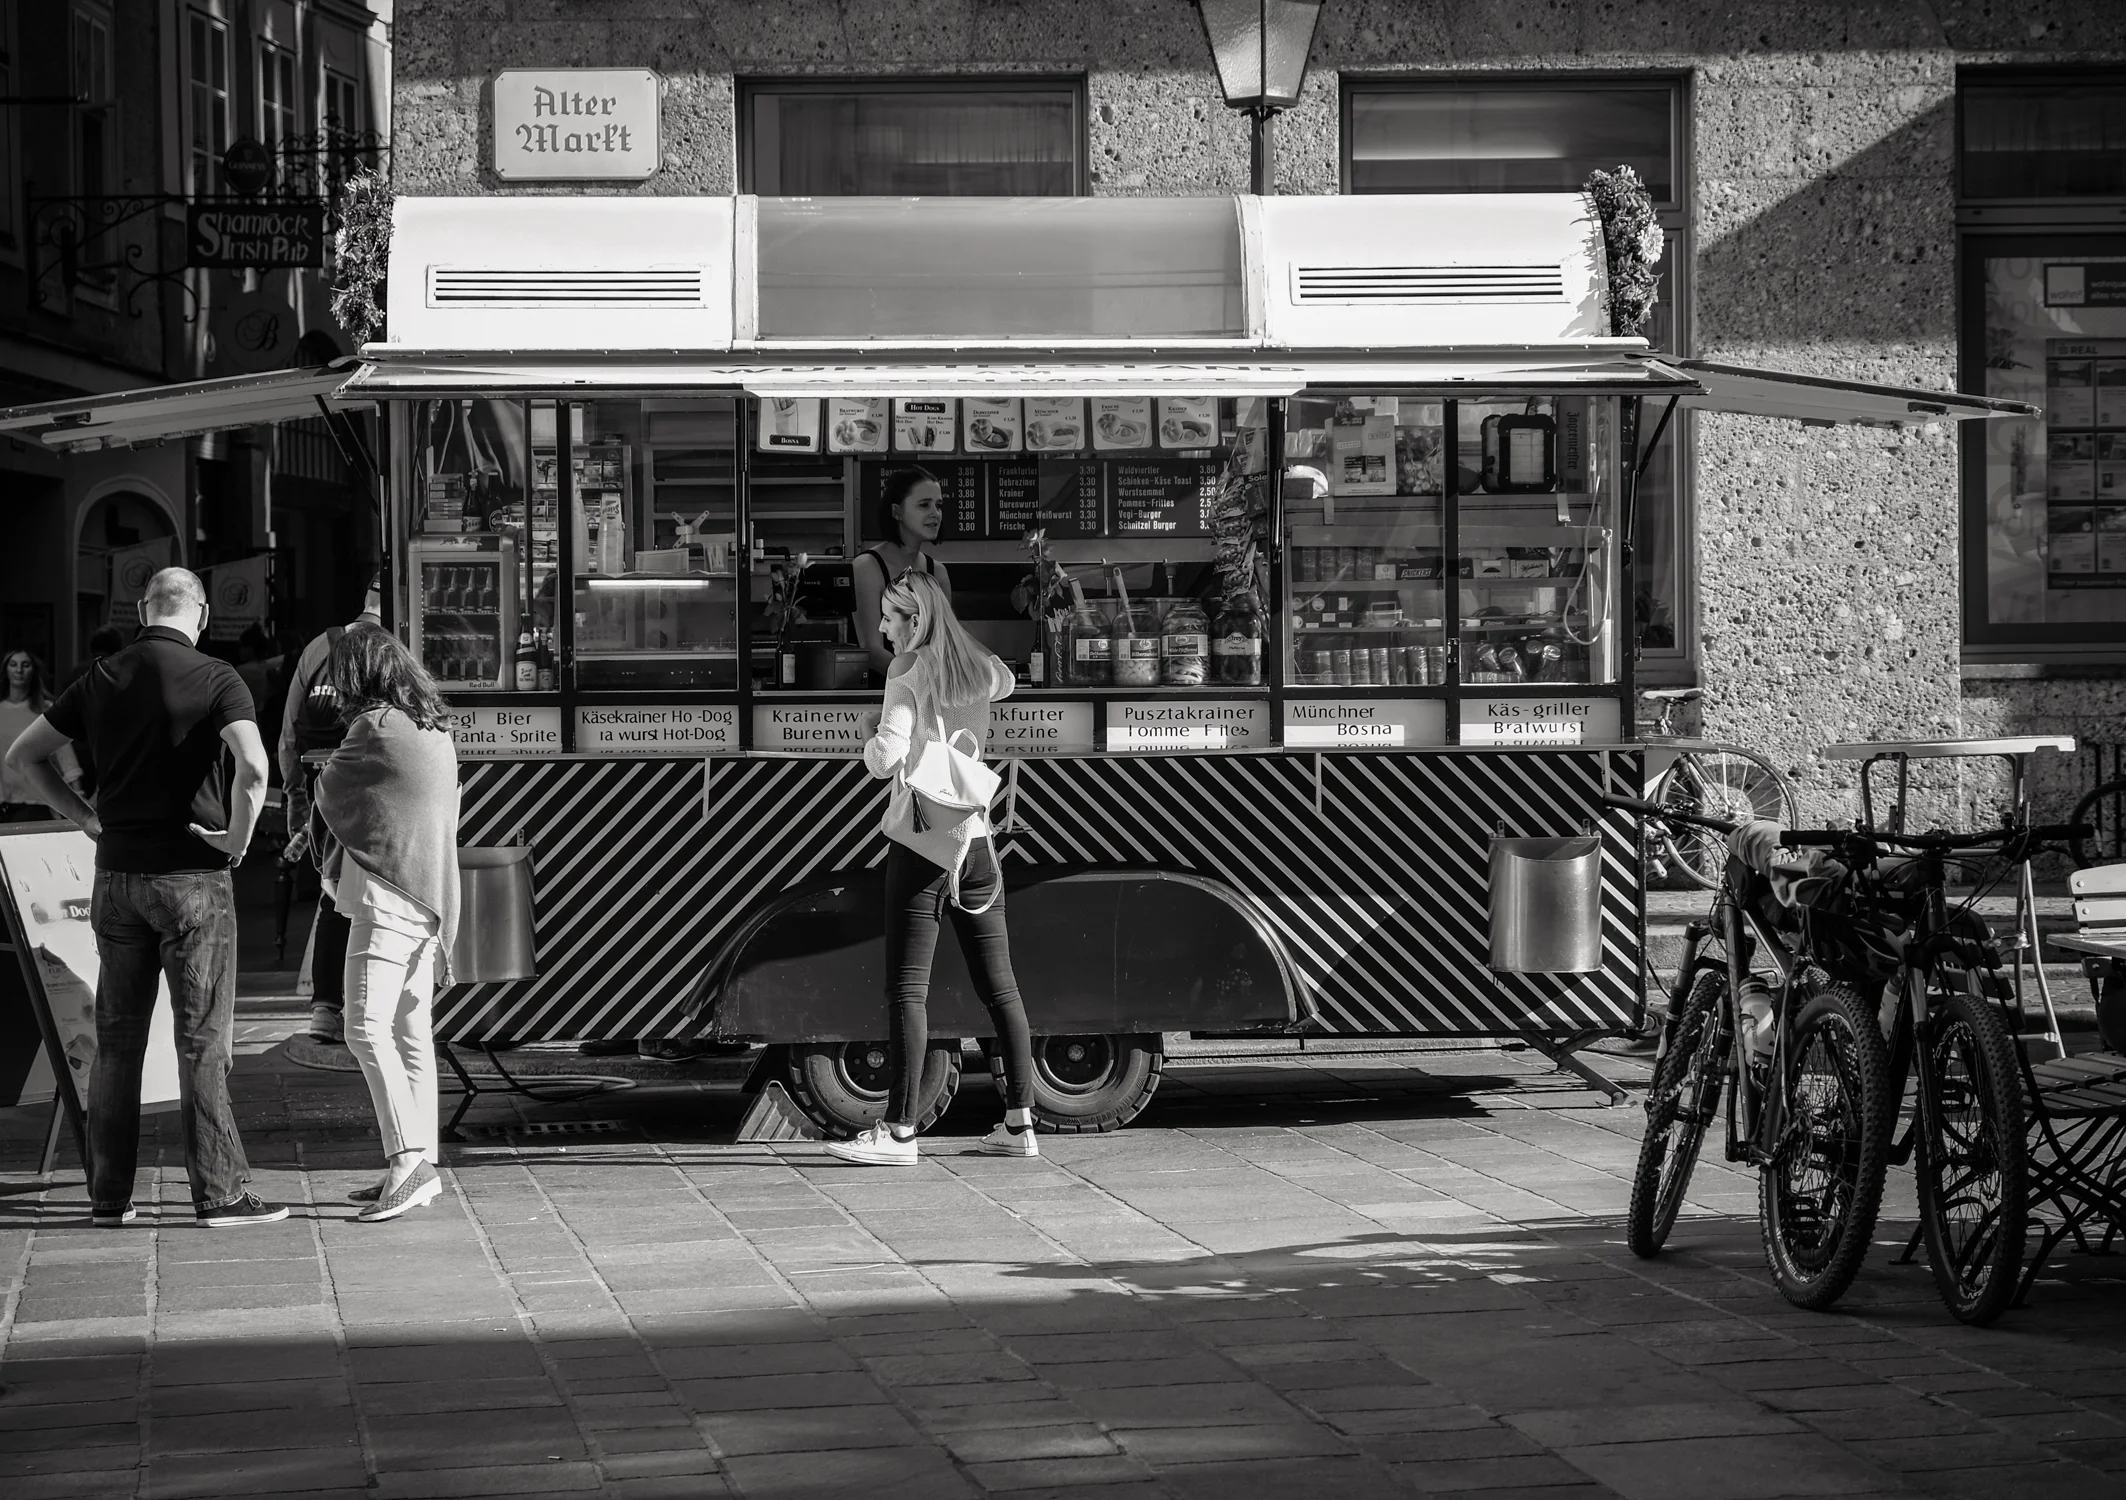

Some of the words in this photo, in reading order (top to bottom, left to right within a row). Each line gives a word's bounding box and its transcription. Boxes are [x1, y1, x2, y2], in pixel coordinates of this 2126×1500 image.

[533, 85, 617, 118] Alter
[515, 123, 633, 153] Markt
[221, 235, 269, 260] Irish
[272, 236, 309, 262] Pub
[998, 466, 1038, 476] Frankfurter
[1118, 466, 1160, 475] Waldviertler
[998, 478, 1037, 487] Debreziner
[1174, 476, 1192, 485] Toast
[999, 489, 1025, 498] Krainer
[1118, 487, 1165, 497] Wurstsemmel
[999, 500, 1039, 509] Burenwurst
[1200, 498, 1211, 507] 2,5
[999, 510, 1033, 520] Münchner
[1036, 510, 1073, 520] Weißwurst
[1118, 510, 1162, 519] Vegi-Burger
[999, 522, 1026, 531] Frische
[1118, 520, 1151, 530] Schnitzel
[1153, 520, 1177, 531] Burger
[582, 709, 666, 724] Käsekrainer
[773, 710, 865, 724] Krainerw
[989, 708, 1065, 722] nkfurter
[1125, 706, 1255, 720] Pusztakrainer
[1292, 705, 1375, 719] Münchner
[449, 712, 476, 728] egl
[497, 712, 532, 725] Bier
[783, 726, 863, 740] Burenwu
[1338, 723, 1392, 736] Bosna
[1494, 721, 1585, 734] Bratwurst
[453, 729, 496, 743] Fanta
[511, 729, 557, 744] Sprite
[664, 728, 726, 743] Hot-Dog
